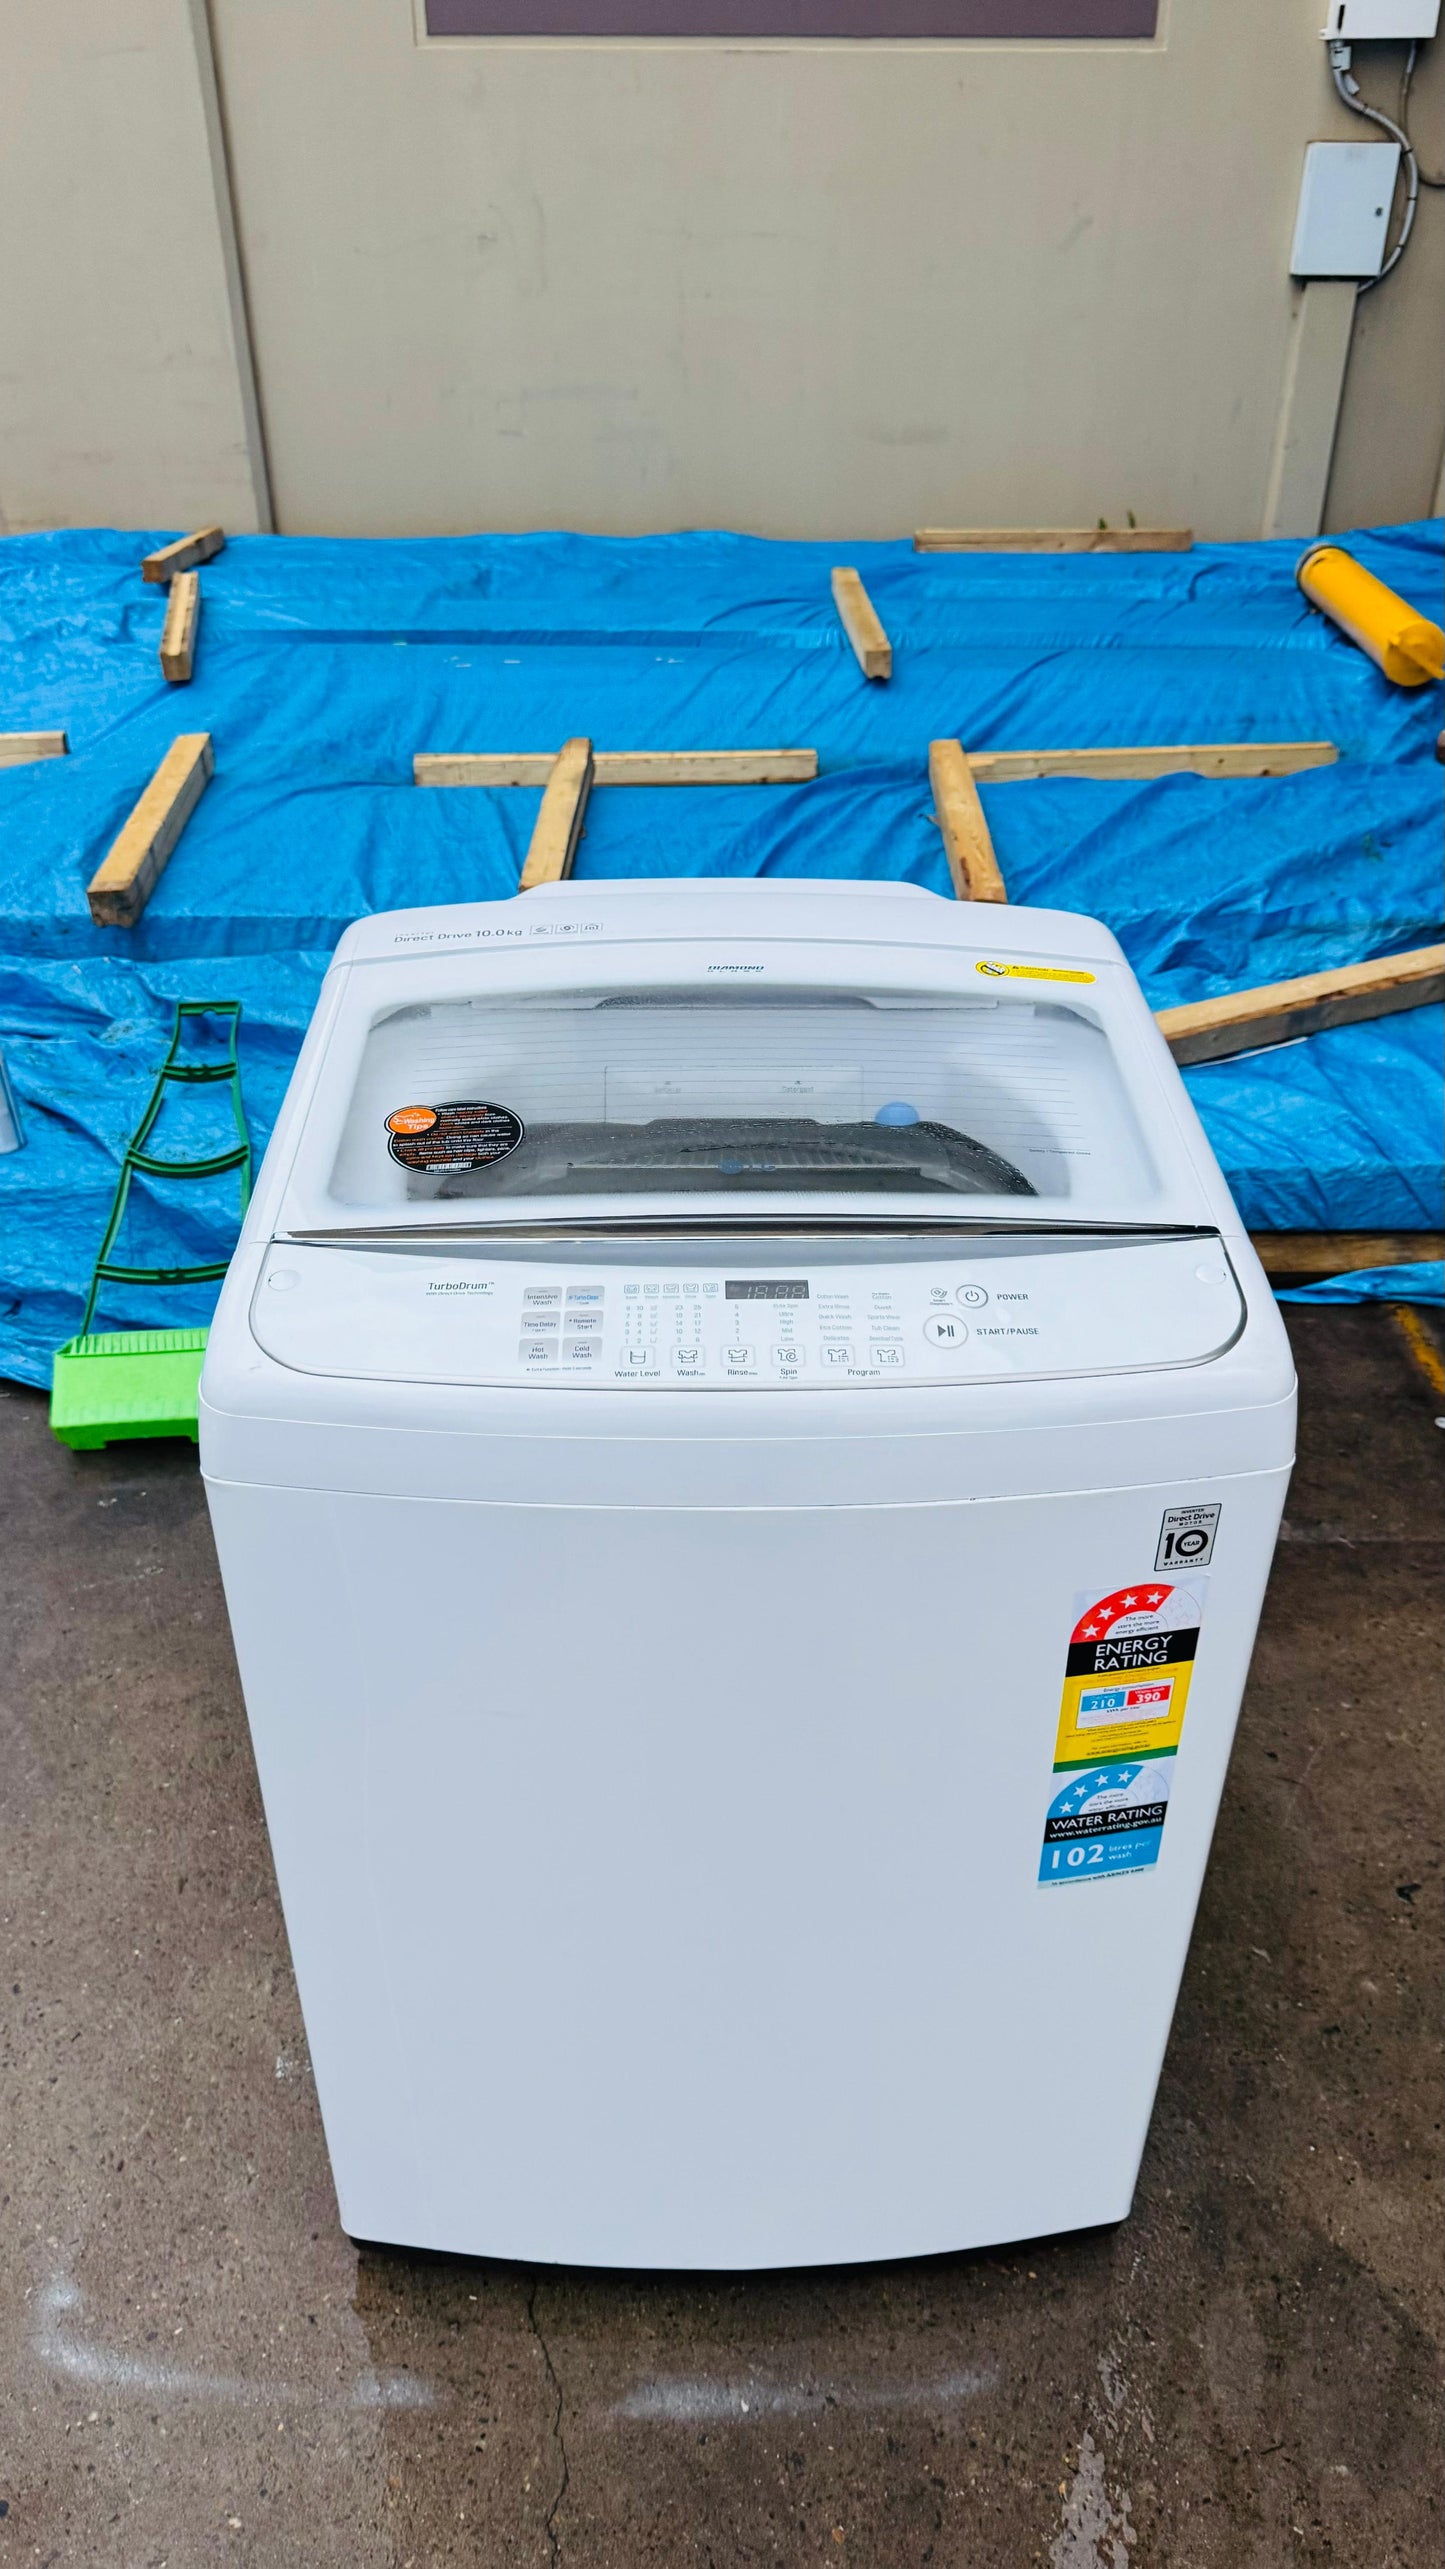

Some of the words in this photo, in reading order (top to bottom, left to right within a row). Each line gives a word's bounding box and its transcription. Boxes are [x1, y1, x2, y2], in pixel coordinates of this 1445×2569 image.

[394, 934, 434, 943] Direct
[438, 932, 472, 940] Drive
[1168, 1515, 1192, 1523] Direct
[1165, 1530, 1208, 1559] 10
[1164, 1557, 1203, 1566] WARRANTY
[1096, 1635, 1173, 1657] ENERGY
[1094, 1651, 1168, 1671] RATING
[1091, 1698, 1115, 1710] 210
[1136, 1692, 1160, 1704] 390
[1052, 1815, 1102, 1830] WATER
[1108, 1805, 1163, 1822] RATING
[1049, 1817, 1162, 1839] www.waterrating.gov.au
[1109, 1843, 1132, 1852] litres
[1052, 1844, 1104, 1869] 102
